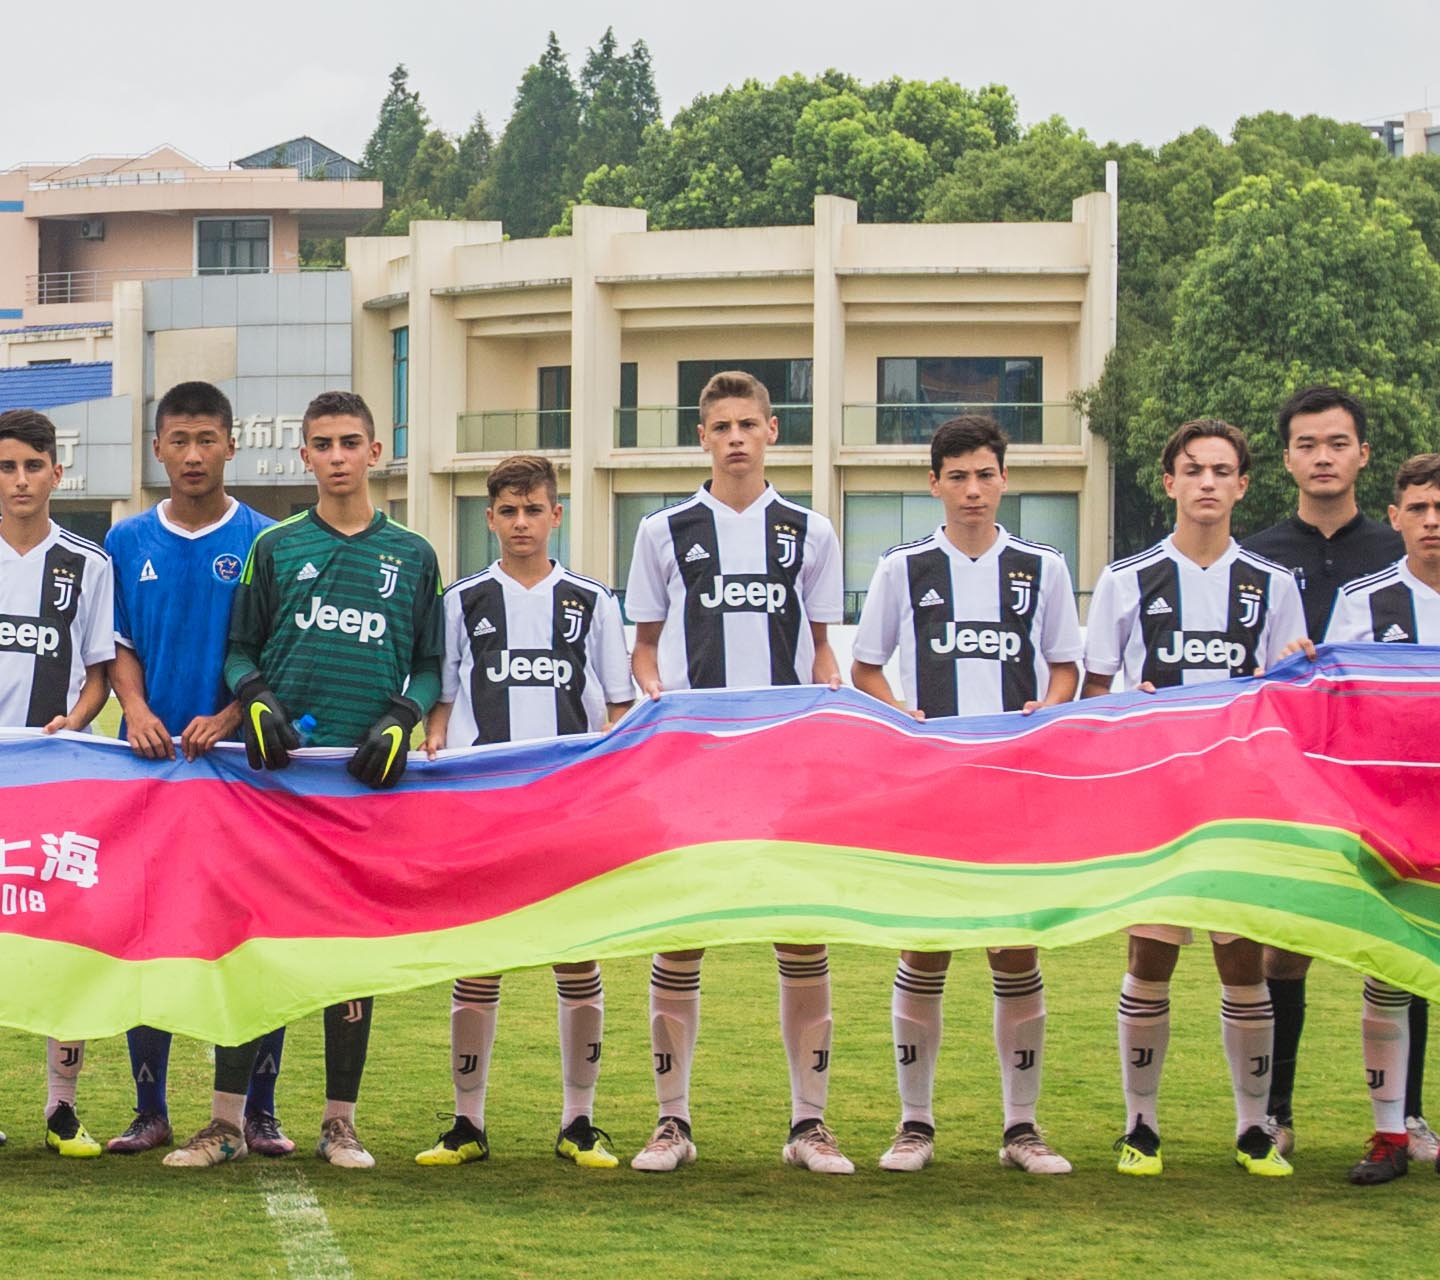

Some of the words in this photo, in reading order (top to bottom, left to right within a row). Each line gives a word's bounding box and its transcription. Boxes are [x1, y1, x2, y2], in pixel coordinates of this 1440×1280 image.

[699, 575, 787, 614] Jeep
[294, 596, 387, 645] Jeep
[930, 621, 1022, 662] Jeep
[1157, 631, 1247, 673] Jeep
[486, 649, 573, 690] Jeep
